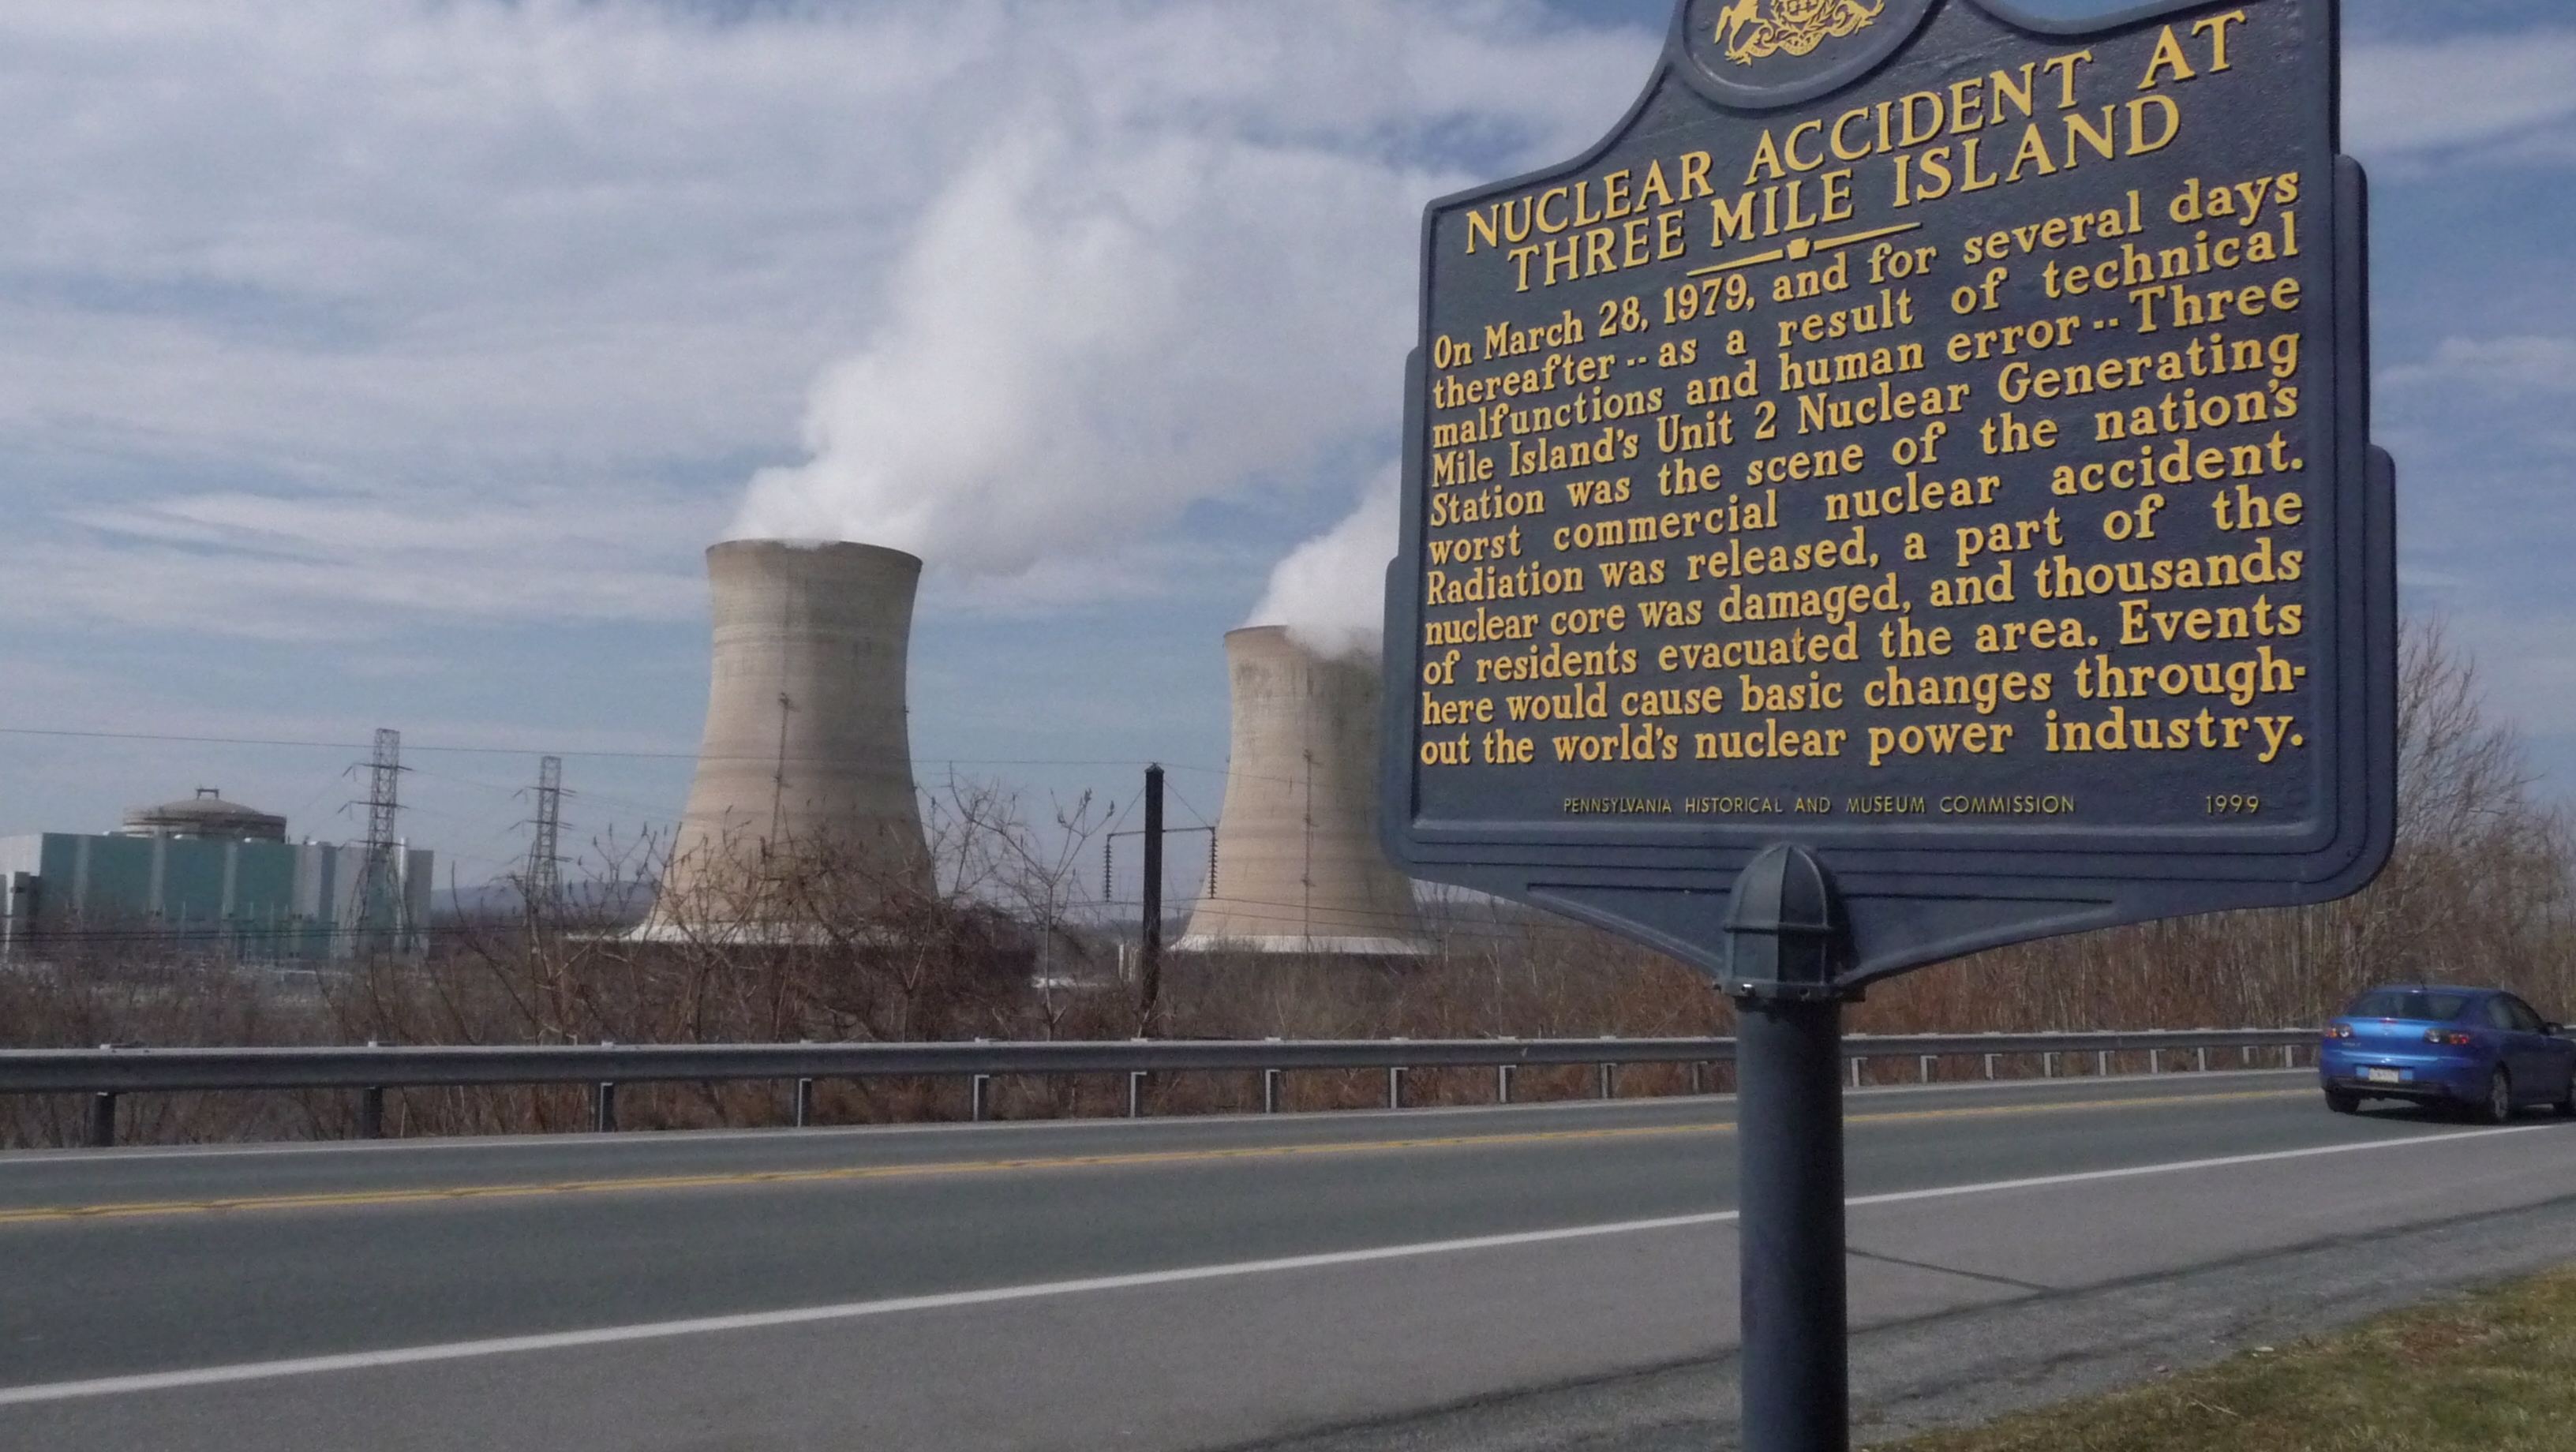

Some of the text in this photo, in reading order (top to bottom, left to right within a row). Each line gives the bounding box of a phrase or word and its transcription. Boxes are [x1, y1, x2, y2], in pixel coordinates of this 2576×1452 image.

[1467, 10, 2245, 253] NUCLEAR ACCIDENT AT
[1509, 95, 2179, 290] THREE MILE ISLAND
[1434, 354, 1615, 409] thereafter
[1659, 339, 1697, 367] as
[1727, 331, 1745, 355] a
[1780, 289, 1912, 346] result
[1953, 268, 2007, 313] of
[2044, 211, 2298, 298] technical
[1435, 172, 2298, 368] On March 28, 1979, and for several days
[1434, 387, 1663, 448] malfunctions
[1687, 359, 1758, 406] and
[1780, 343, 1923, 391] human
[1948, 316, 2080, 361] error
[2130, 278, 2299, 332] Three
[1434, 333, 2300, 486] Mile Island's Unit 2 Nuclear Generating
[1429, 431, 2302, 564] worst commercial nuclear accident.
[1432, 379, 2297, 526] Station was the scene of the nation's
[1427, 537, 2302, 645] nuclear core was damaged, and thousands
[1428, 484, 2302, 604] Radiation was released, a part of the
[1424, 646, 2305, 724] here would cause basic changes through-
[1425, 594, 2301, 684] of residents evacuated the area. Events
[1421, 706, 2303, 766] out the world's nuclear power industry.
[1564, 796, 2075, 814] PENNSYLVANIA HISTORICAL AND MUSEUM COMMISSION
[2206, 795, 2260, 814] 1999
